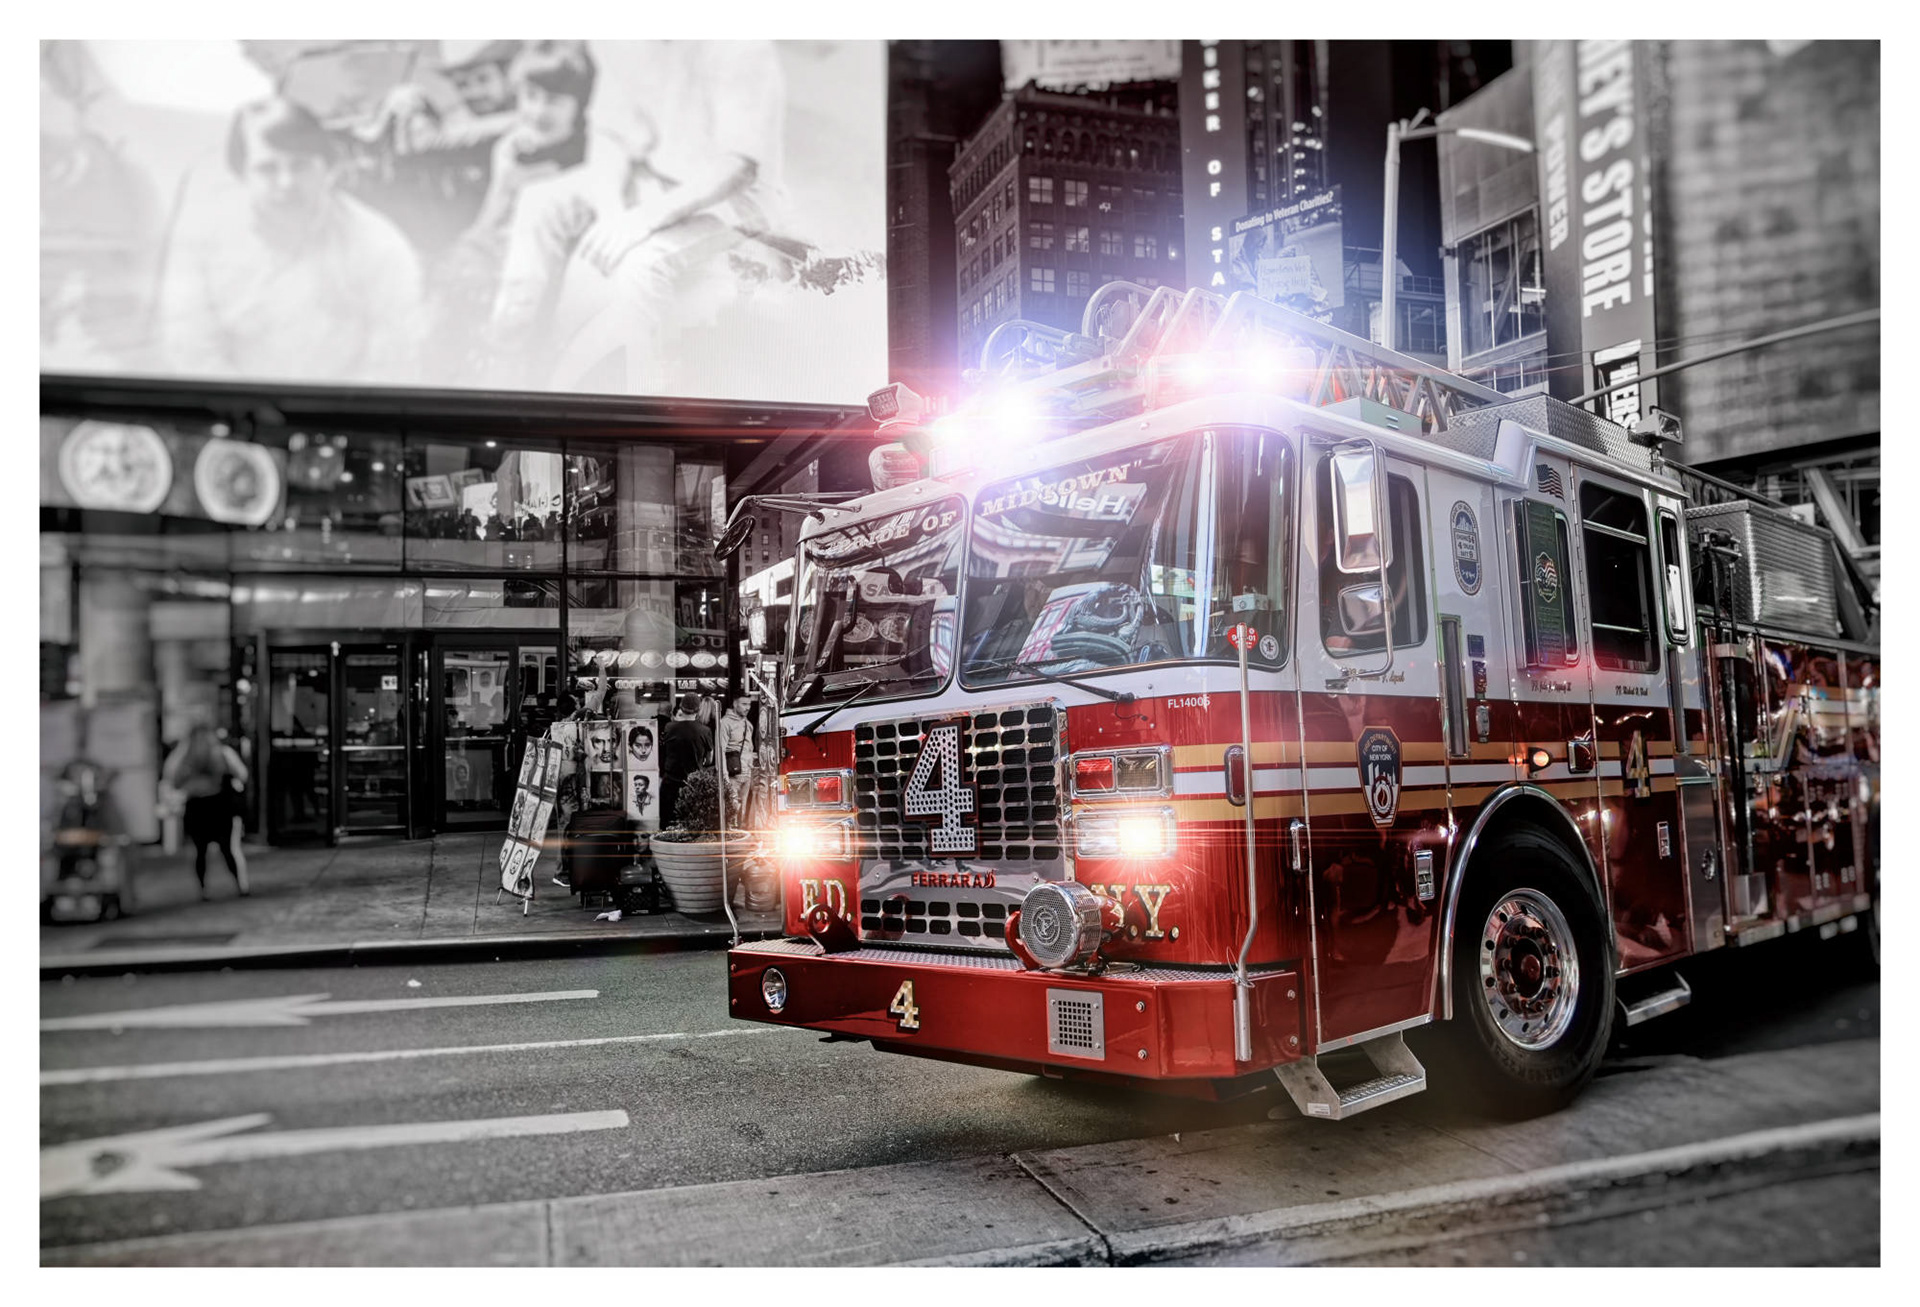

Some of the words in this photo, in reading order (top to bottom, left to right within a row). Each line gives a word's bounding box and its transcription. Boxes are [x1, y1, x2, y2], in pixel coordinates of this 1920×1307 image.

[1207, 159, 1222, 196] OF
[1545, 113, 1569, 251] POWER
[1235, 215, 1265, 233] Donating
[1265, 212, 1273, 223] to
[1273, 203, 1299, 220] Veteran
[1299, 190, 1334, 212] Charities?
[1581, 158, 1634, 318] STORE
[922, 511, 957, 531] OF
[1369, 753, 1380, 761] NEW
[1379, 753, 1392, 761] YORK
[1371, 744, 1381, 752] CITY
[1381, 744, 1388, 752] OF
[1626, 730, 1650, 799] 4
[904, 724, 977, 853] 4
[911, 872, 981, 890] FERRARA
[890, 980, 920, 1030] 4
